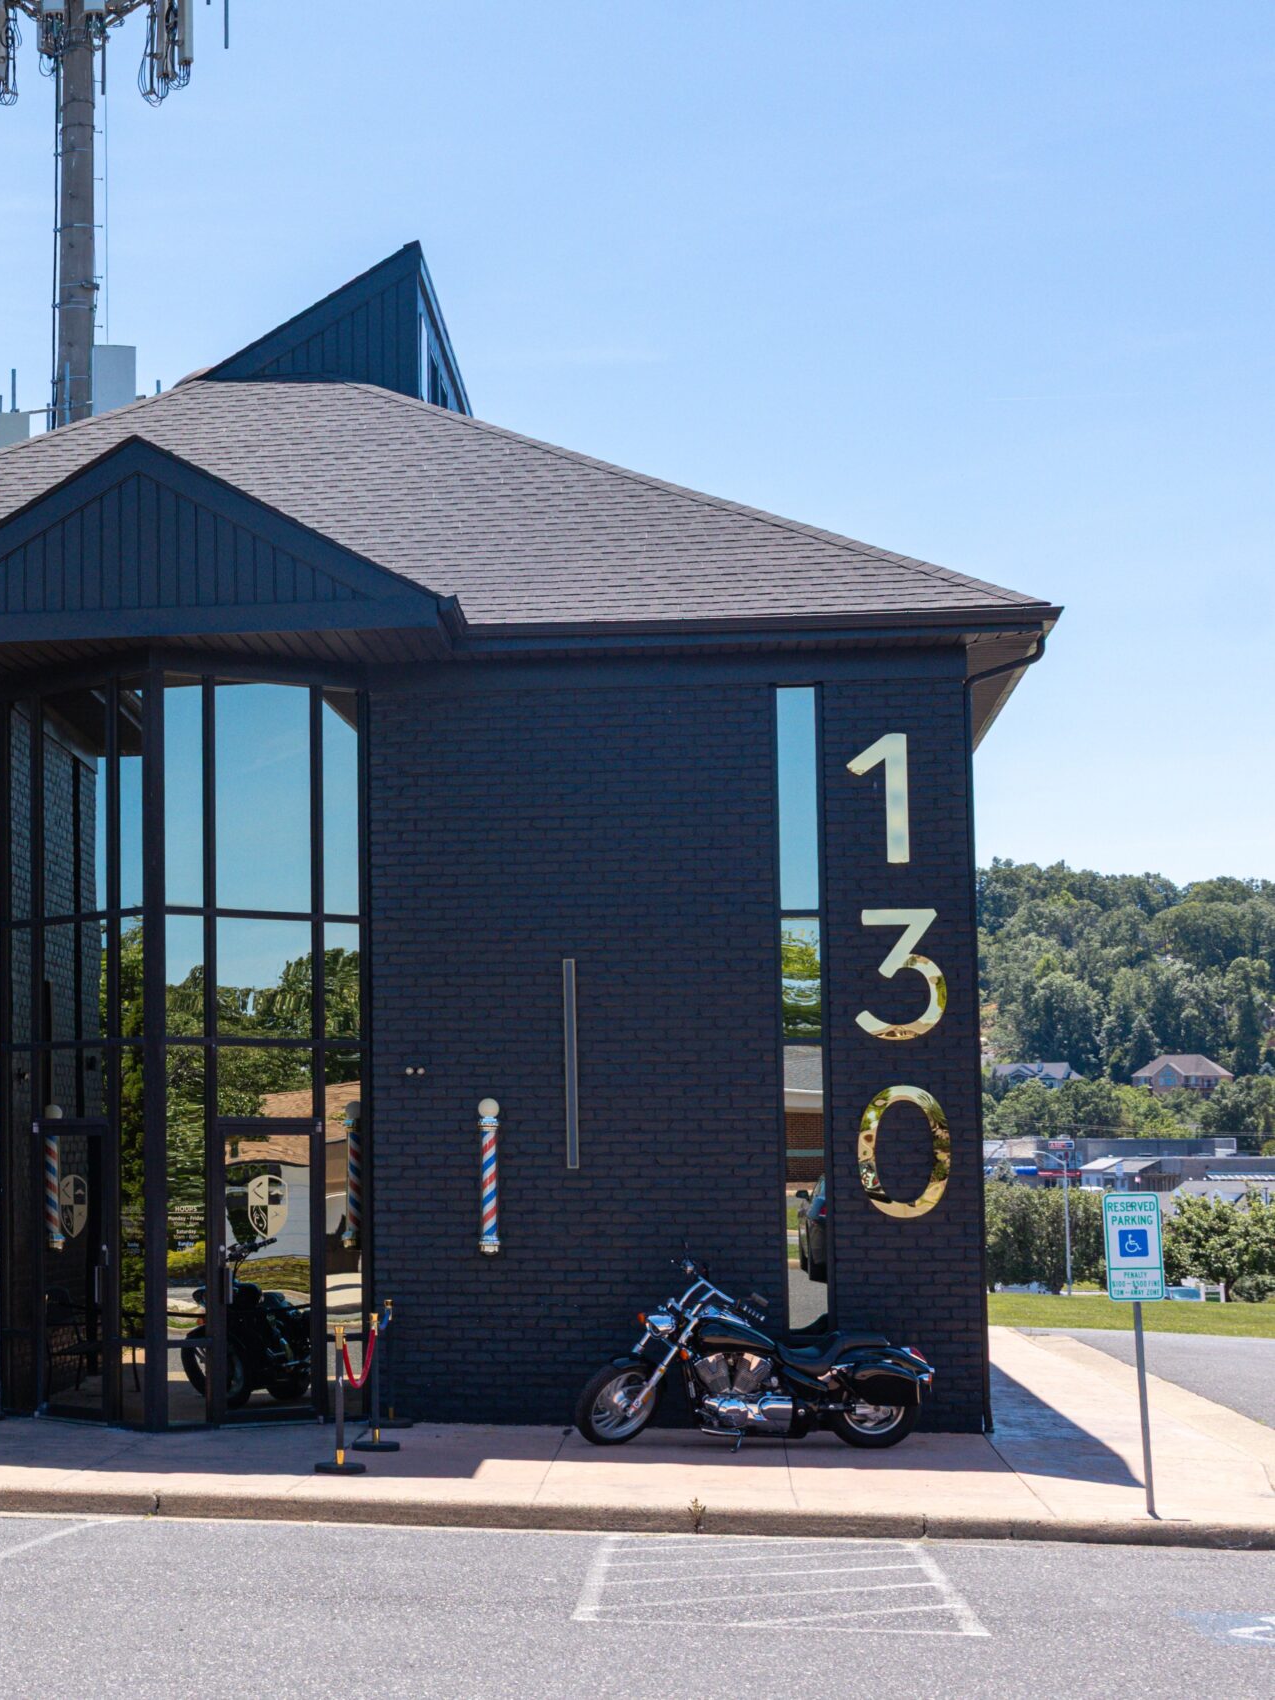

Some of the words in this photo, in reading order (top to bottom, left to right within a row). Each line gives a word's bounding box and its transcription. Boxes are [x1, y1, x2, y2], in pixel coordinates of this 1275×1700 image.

[1107, 1201, 1156, 1212] RESERVED
[1111, 1215, 1153, 1225] PARKING
[1123, 1271, 1147, 1279] PENALTY
